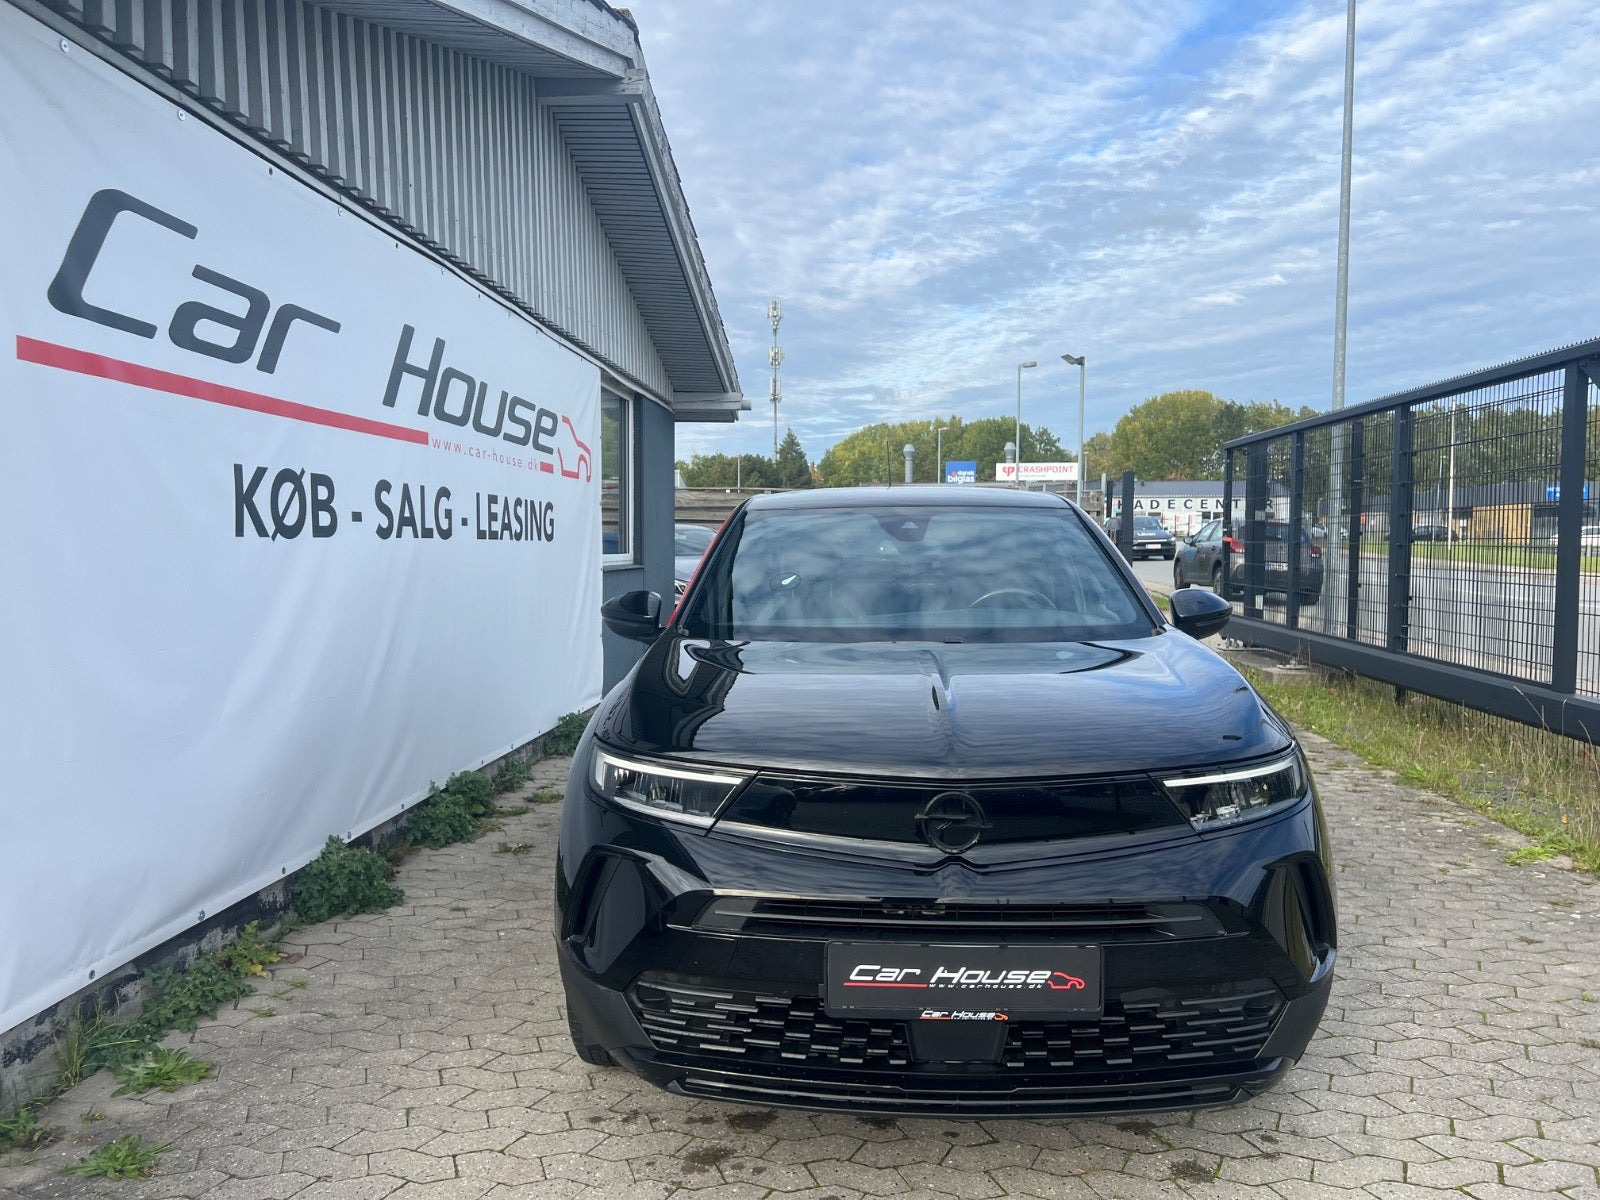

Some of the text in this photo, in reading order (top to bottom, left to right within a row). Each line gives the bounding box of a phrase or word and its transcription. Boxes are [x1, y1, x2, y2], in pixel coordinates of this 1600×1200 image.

[47, 188, 559, 455] Car House
[431, 438, 538, 471] www.car-house.dk
[1017, 465, 1073, 473] CRASHPOINT
[233, 463, 338, 542] KØB
[374, 479, 453, 540] SALG
[475, 492, 555, 542] LEASING
[849, 965, 1052, 984] Car House
[921, 1010, 949, 1018] Car
[950, 1010, 996, 1019] House
